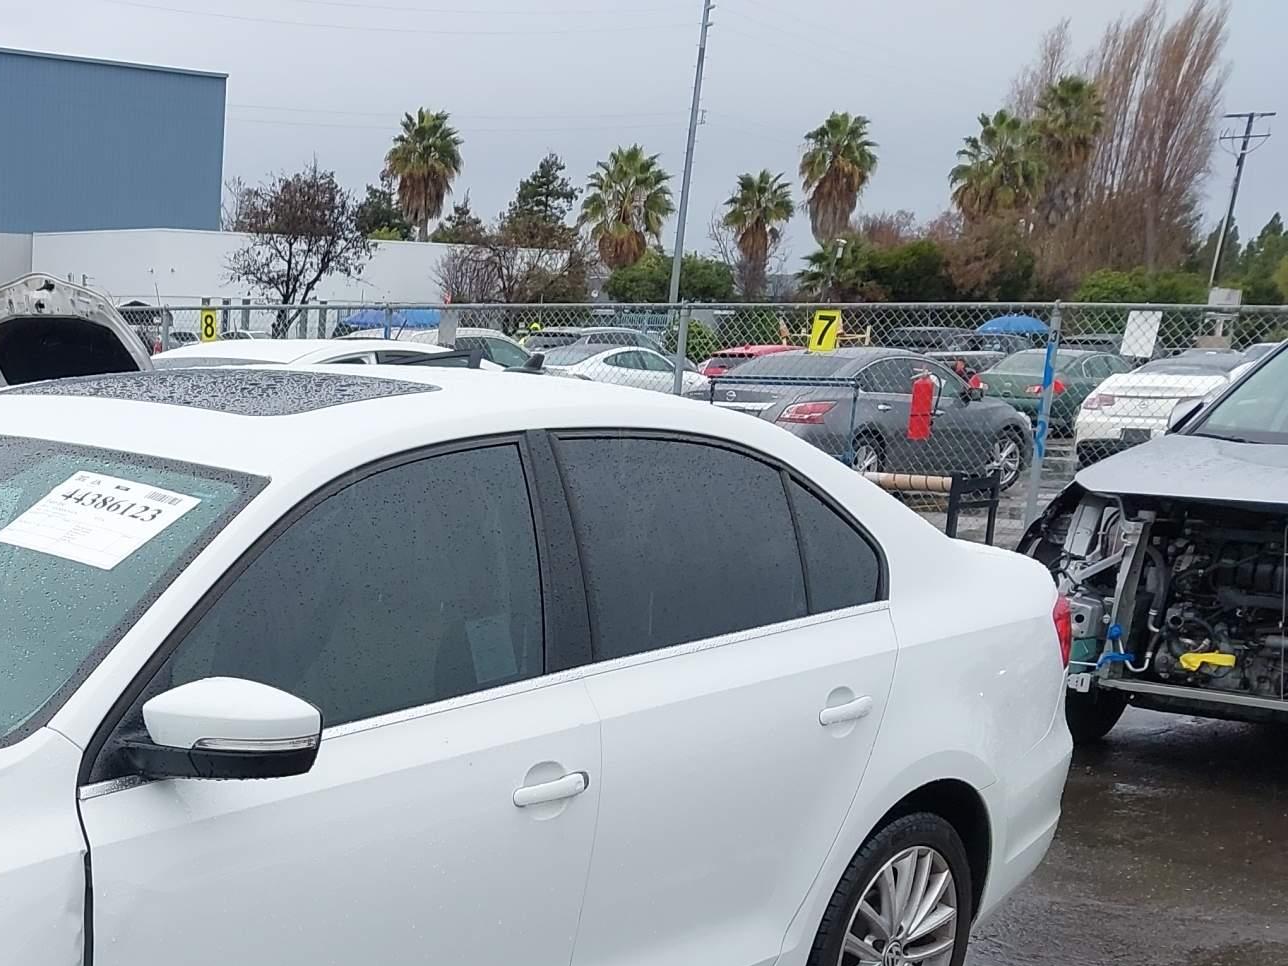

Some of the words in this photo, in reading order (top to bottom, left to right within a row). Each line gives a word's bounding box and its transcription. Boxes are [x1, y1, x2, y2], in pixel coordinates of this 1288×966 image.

[204, 314, 214, 338] 8
[817, 315, 836, 345] 7
[61, 488, 163, 522] 44386123
